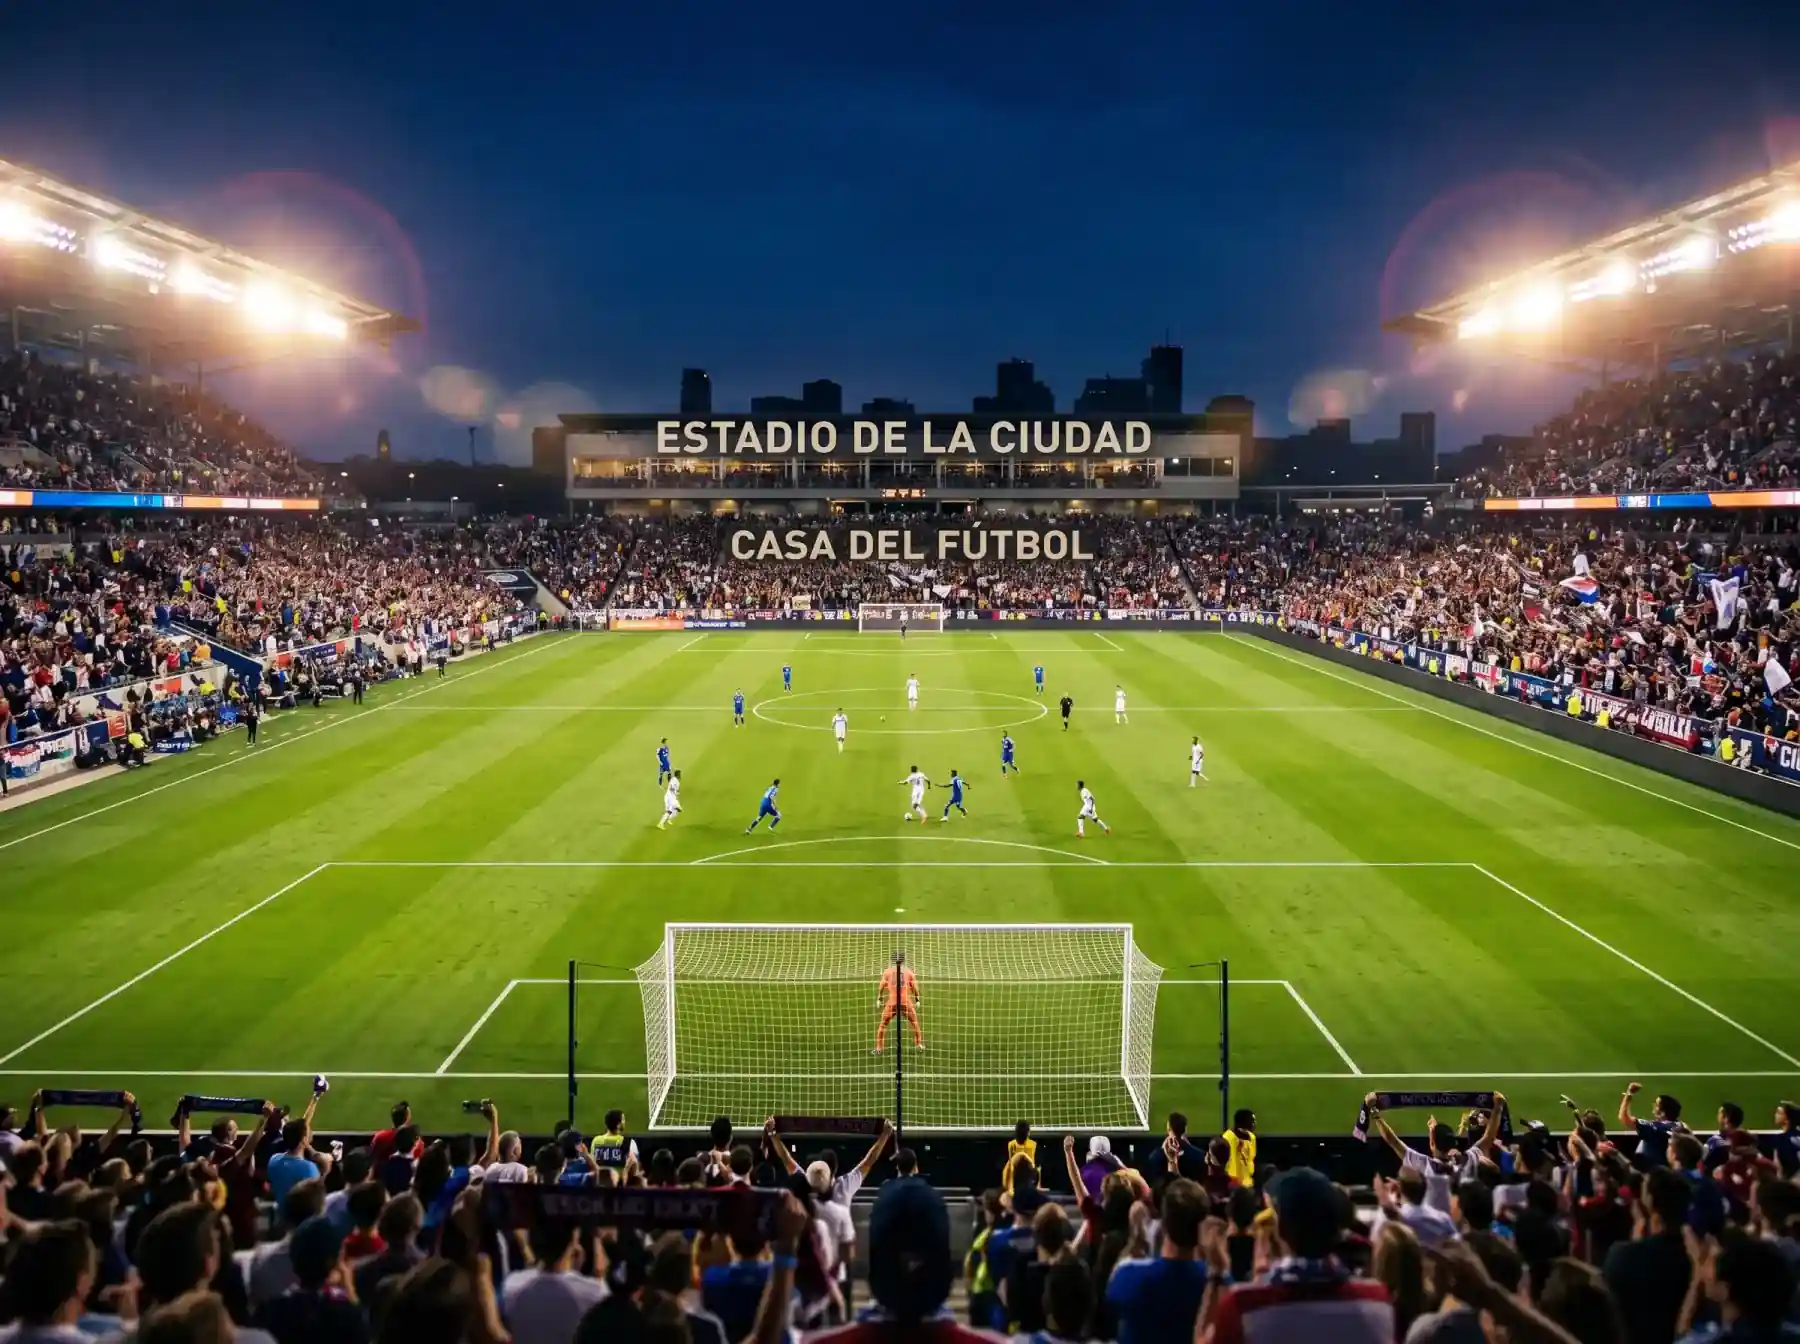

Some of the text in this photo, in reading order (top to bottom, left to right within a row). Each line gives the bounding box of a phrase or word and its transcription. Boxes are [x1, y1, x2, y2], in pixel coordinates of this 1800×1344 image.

[657, 420, 1151, 454] ESTADIO DE LA CIUDAD
[731, 521, 1094, 560] CASA DEL FÚTBOL
